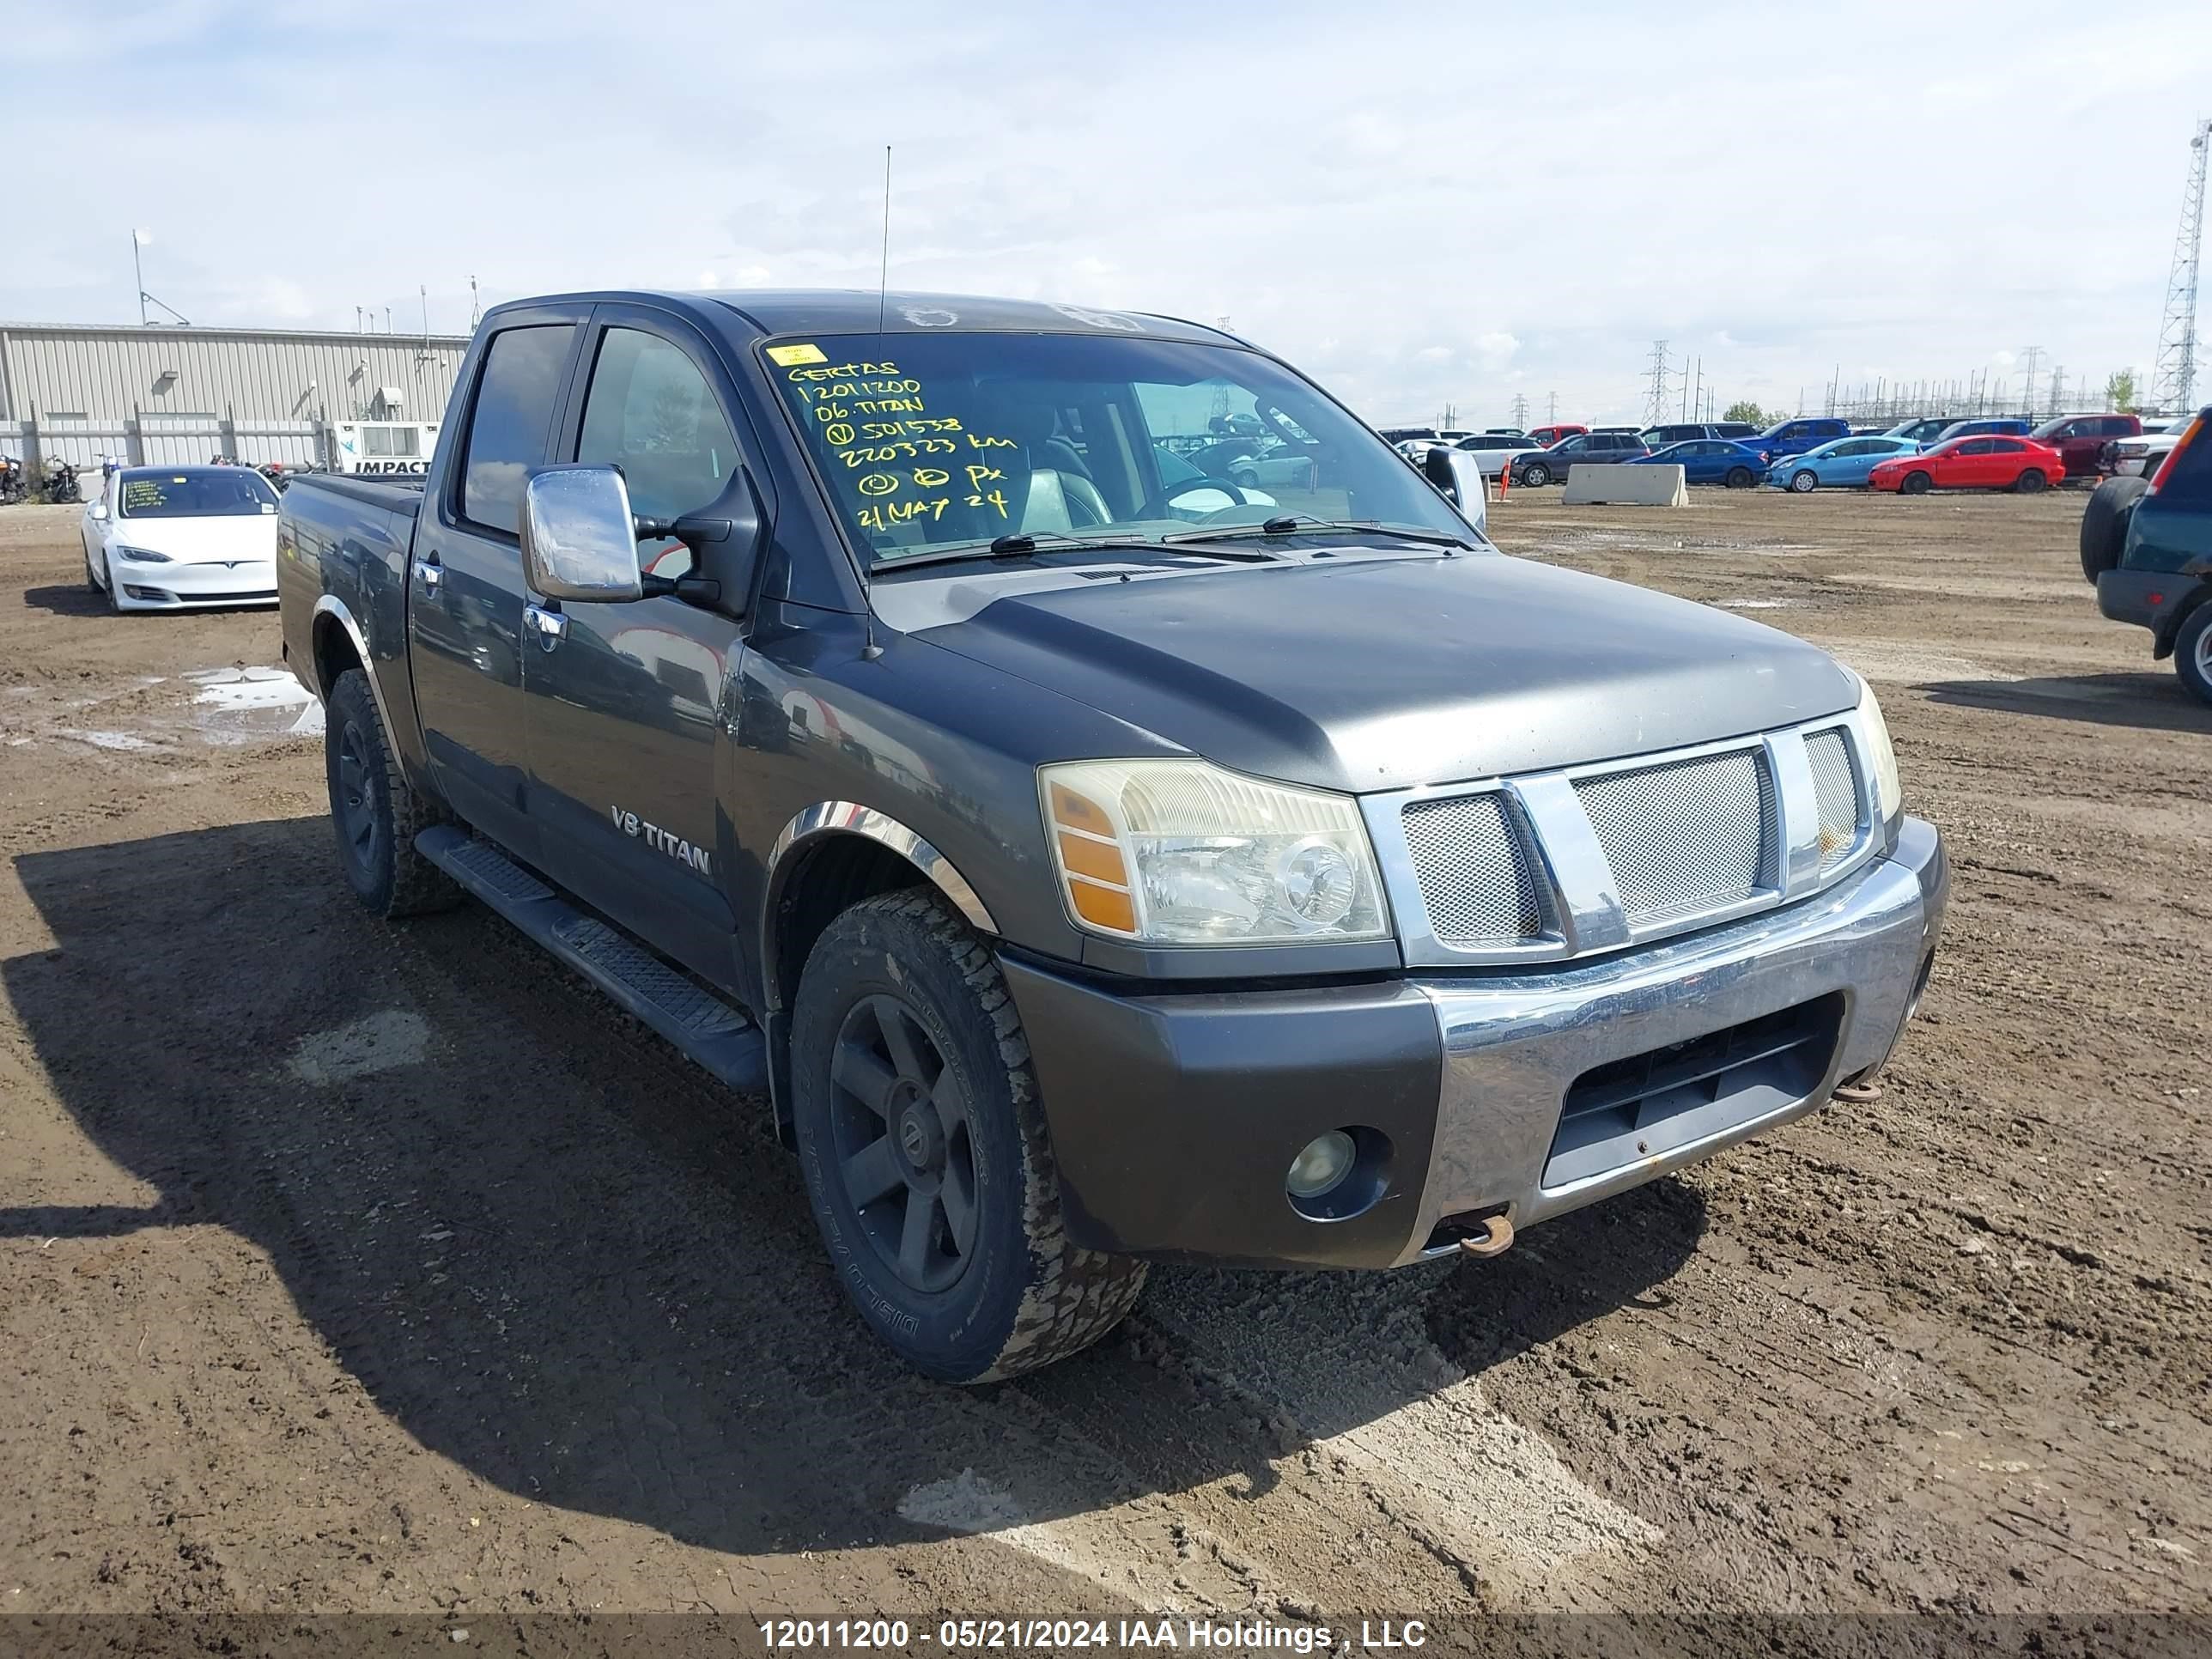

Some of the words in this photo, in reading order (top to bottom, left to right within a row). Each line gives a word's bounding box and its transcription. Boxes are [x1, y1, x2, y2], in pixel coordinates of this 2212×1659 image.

[355, 461, 431, 474] IMPACT
[838, 438, 957, 468] 220323
[963, 489, 1010, 520] 24
[611, 805, 641, 838] V8
[642, 820, 711, 875] TITAN
